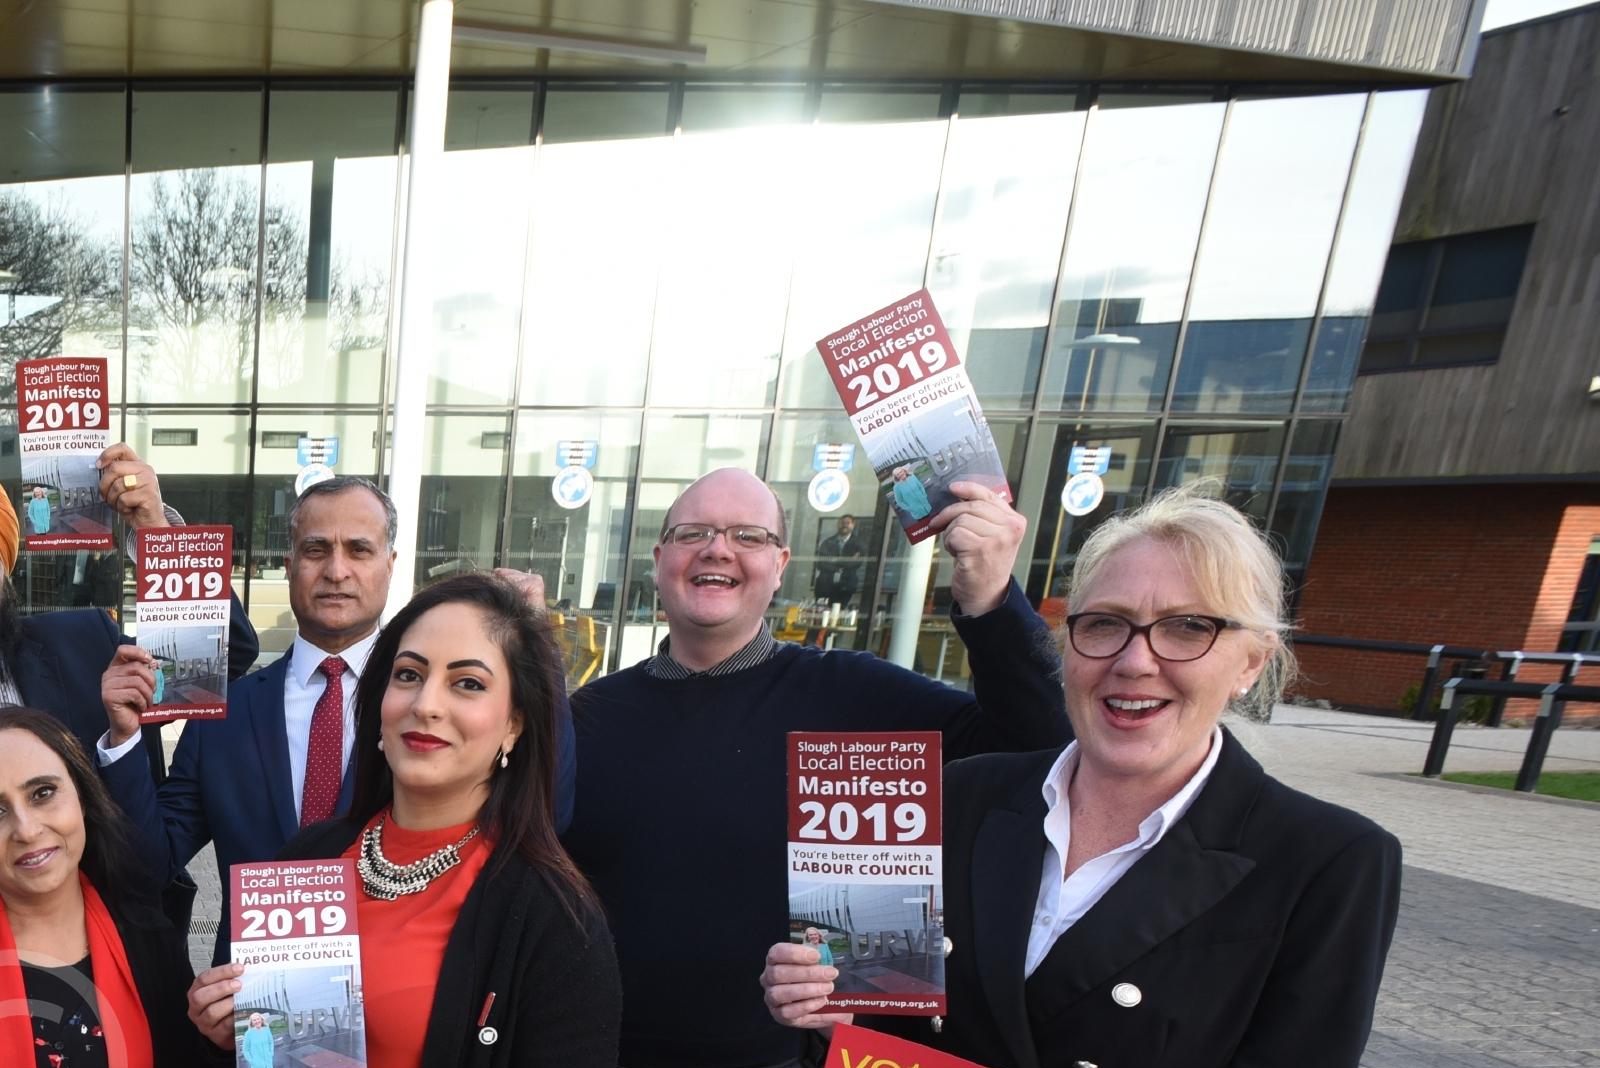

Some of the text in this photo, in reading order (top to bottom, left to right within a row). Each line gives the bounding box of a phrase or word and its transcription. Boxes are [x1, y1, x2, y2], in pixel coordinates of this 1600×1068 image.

[827, 298, 923, 349] Slough Labour Party
[833, 309, 927, 360] Local Election
[839, 325, 935, 377] Manifesto
[24, 363, 100, 374] Slough Labour Party
[848, 342, 947, 409] 2019
[24, 372, 100, 385] Local Election
[25, 386, 101, 401] Manifesto
[860, 382, 965, 435] LABOUR COUNCIL
[26, 402, 101, 430] 2019
[23, 440, 106, 452] LABOUR COUNCIL
[145, 533, 171, 541] Slough
[203, 532, 224, 541] Party
[146, 541, 223, 553] Local Election
[145, 556, 224, 569] Manifesto
[145, 572, 223, 598] 2019
[140, 612, 225, 622] LABOUR COUNCIL
[798, 742, 926, 754] Slough Labour Party
[799, 755, 925, 771] Local Election
[799, 776, 927, 796] Manifesto
[799, 801, 926, 842] 2019
[793, 850, 828, 860] You're
[831, 851, 868, 860] better
[872, 852, 888, 861] off
[893, 852, 921, 861] with
[241, 865, 344, 877] Slough Labour Party
[793, 861, 933, 875] LABOUR COUNCIL
[242, 875, 343, 889] Local Election
[241, 889, 345, 906] Manifesto
[241, 906, 346, 938] 2019
[236, 945, 267, 954] You're
[271, 944, 301, 952] better
[294, 950, 353, 960] COUNCIL
